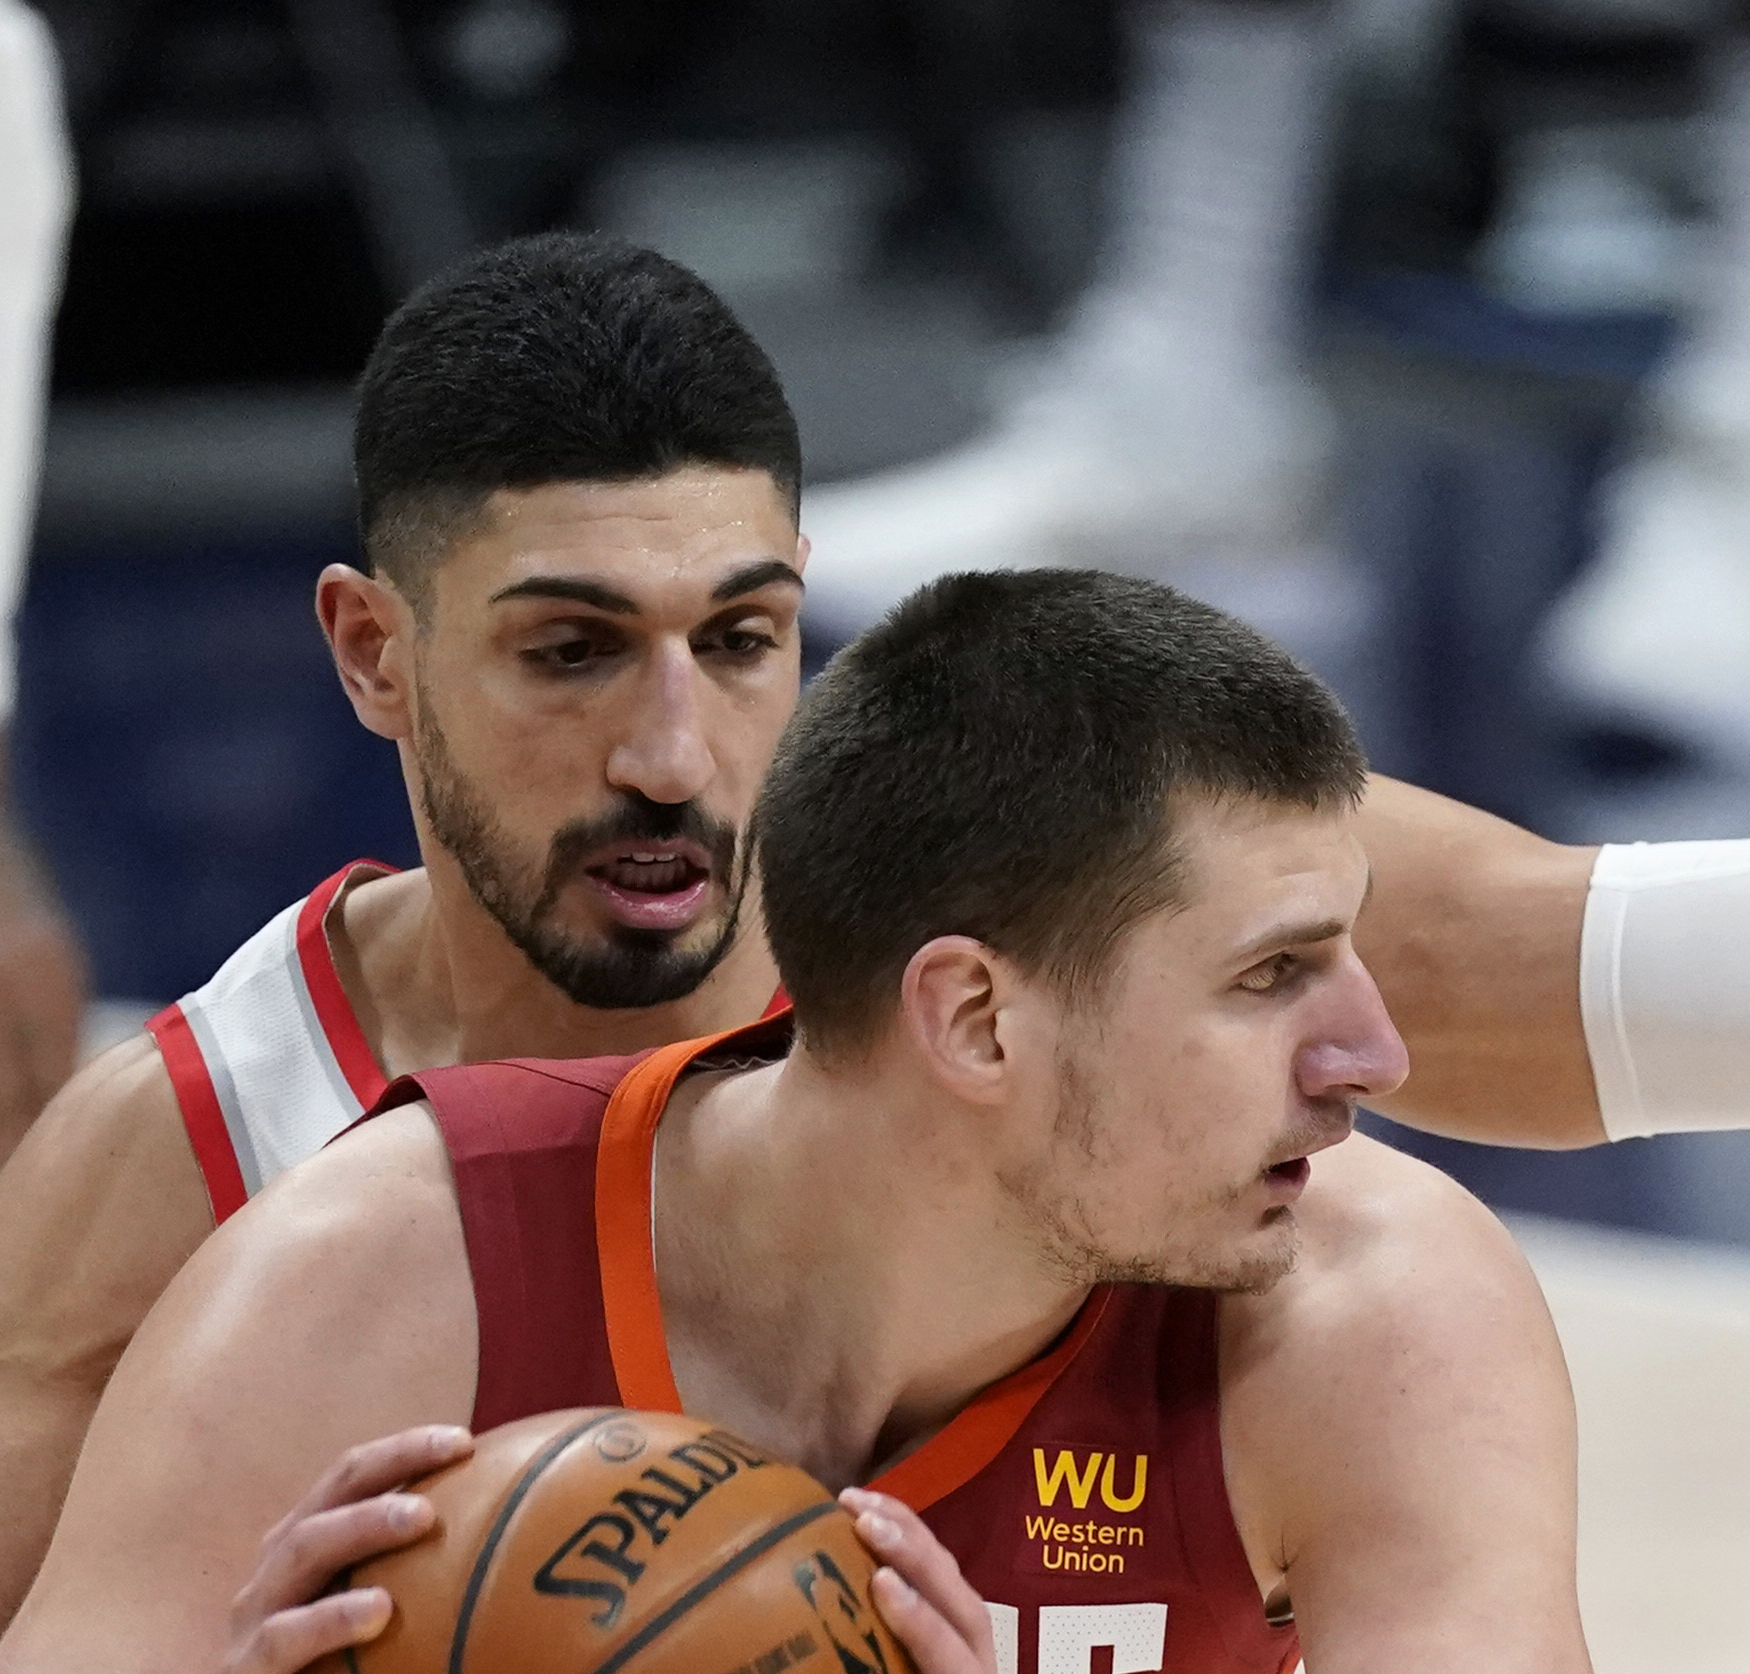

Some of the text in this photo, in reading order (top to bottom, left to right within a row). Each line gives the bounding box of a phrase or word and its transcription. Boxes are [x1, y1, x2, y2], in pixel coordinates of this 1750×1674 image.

[1033, 1448, 1148, 1513] WU
[533, 1431, 767, 1629] SPALDI
[1025, 1515, 1145, 1546] Western
[1043, 1544, 1125, 1573] Union
